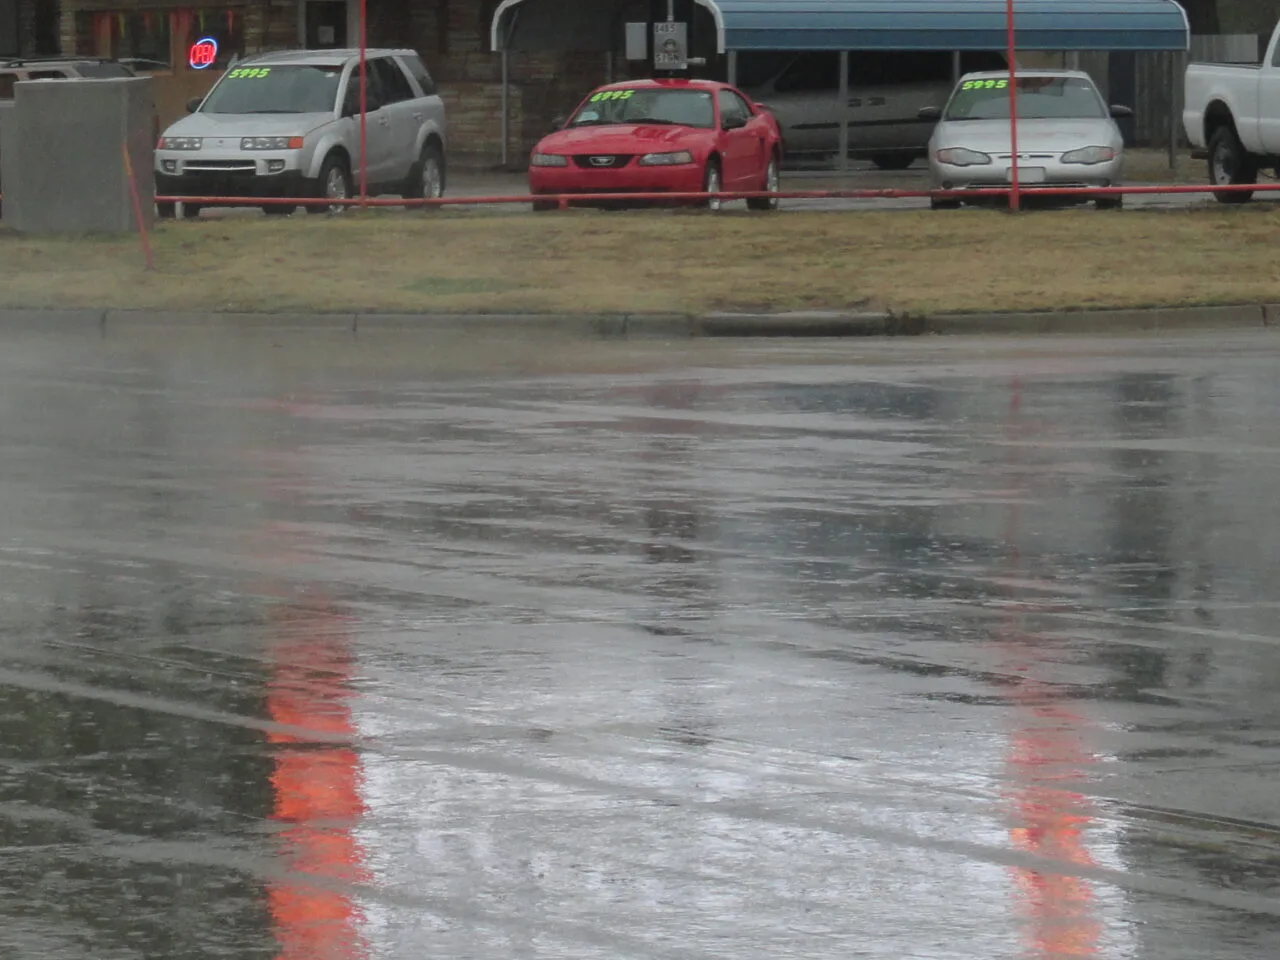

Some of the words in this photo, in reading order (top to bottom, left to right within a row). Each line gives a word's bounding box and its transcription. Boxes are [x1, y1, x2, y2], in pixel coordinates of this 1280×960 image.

[190, 44, 215, 64] OPEN
[228, 68, 271, 79] 5995
[961, 80, 1009, 91] 5995
